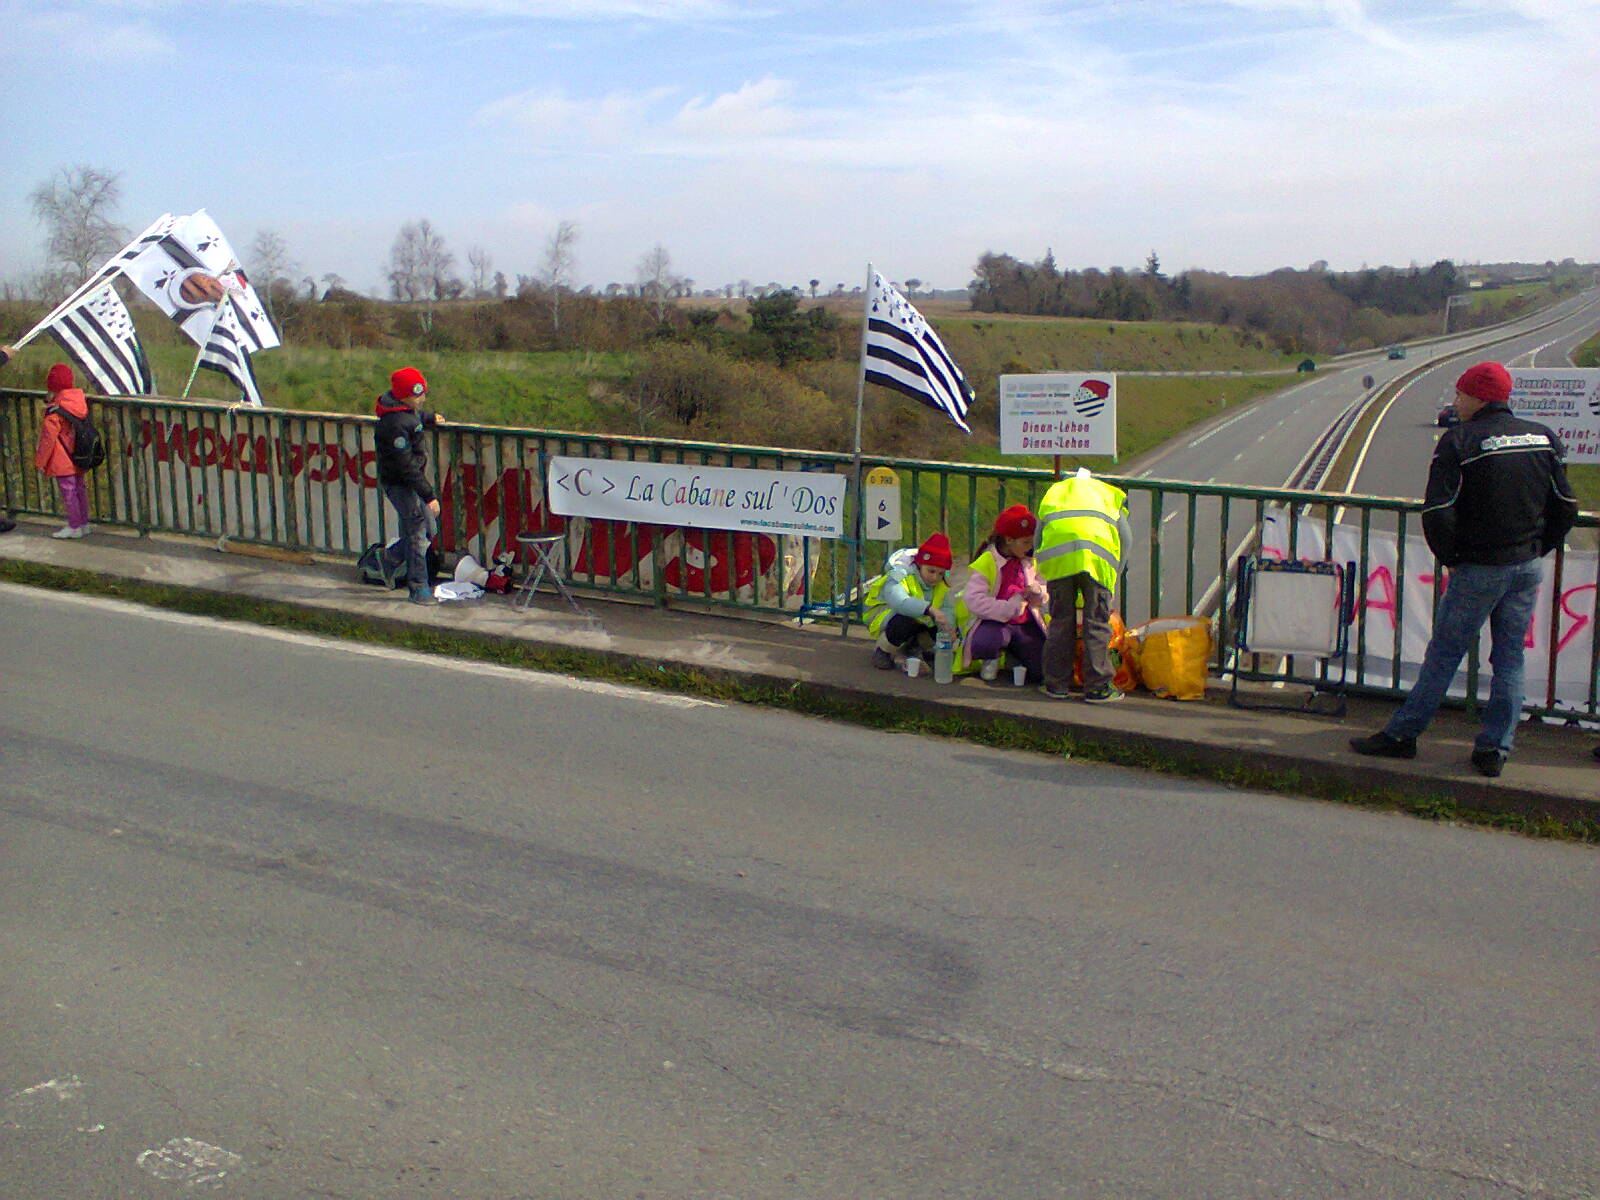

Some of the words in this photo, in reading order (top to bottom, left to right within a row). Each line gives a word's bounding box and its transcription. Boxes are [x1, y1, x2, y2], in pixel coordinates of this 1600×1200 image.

[1558, 427, 1600, 439] Saint-
[624, 475, 654, 501] La
[661, 476, 736, 508] Cabane
[792, 486, 837, 516] Dos
[878, 499, 886, 512] 6
